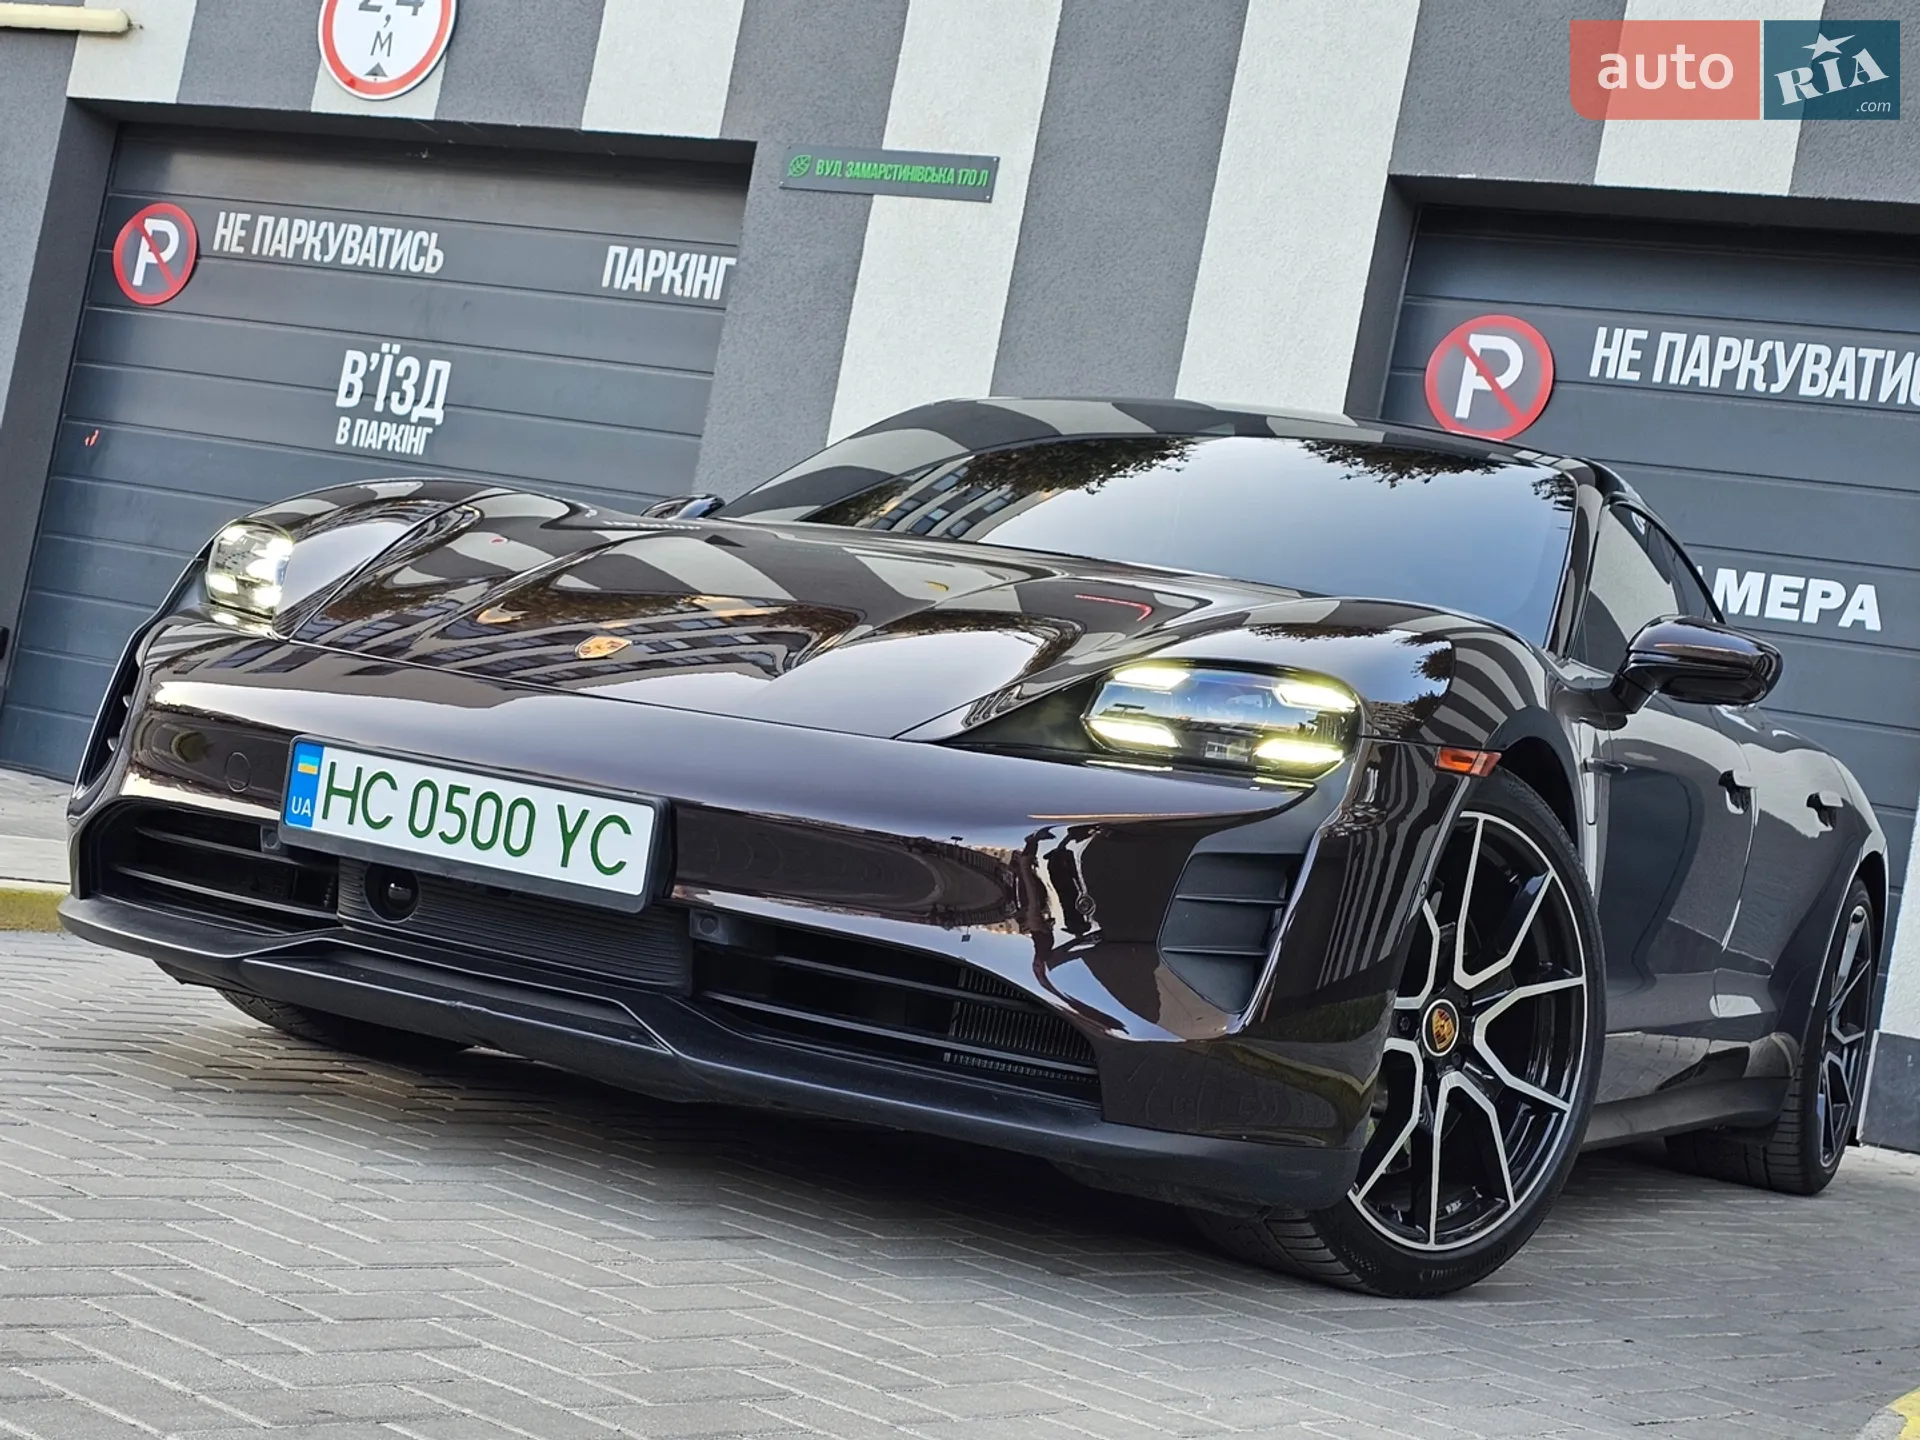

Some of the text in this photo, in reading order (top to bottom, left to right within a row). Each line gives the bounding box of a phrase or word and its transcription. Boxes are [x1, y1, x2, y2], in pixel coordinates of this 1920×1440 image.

[845, 160, 956, 185] ЗАМАРСТИНІВСЬКА
[958, 167, 978, 186] 170
[212, 211, 445, 275] НЕ ПАРКУВАТИСЬ
[601, 245, 737, 301] ПАРКІНГ
[1588, 326, 1649, 381] НЕ
[335, 342, 452, 426] В'ЇЗД
[335, 416, 434, 456] В ПАРКІНГ
[1697, 566, 1882, 632] МЕРА
[290, 794, 312, 818] UA
[321, 761, 633, 877] HC 0500 YC
